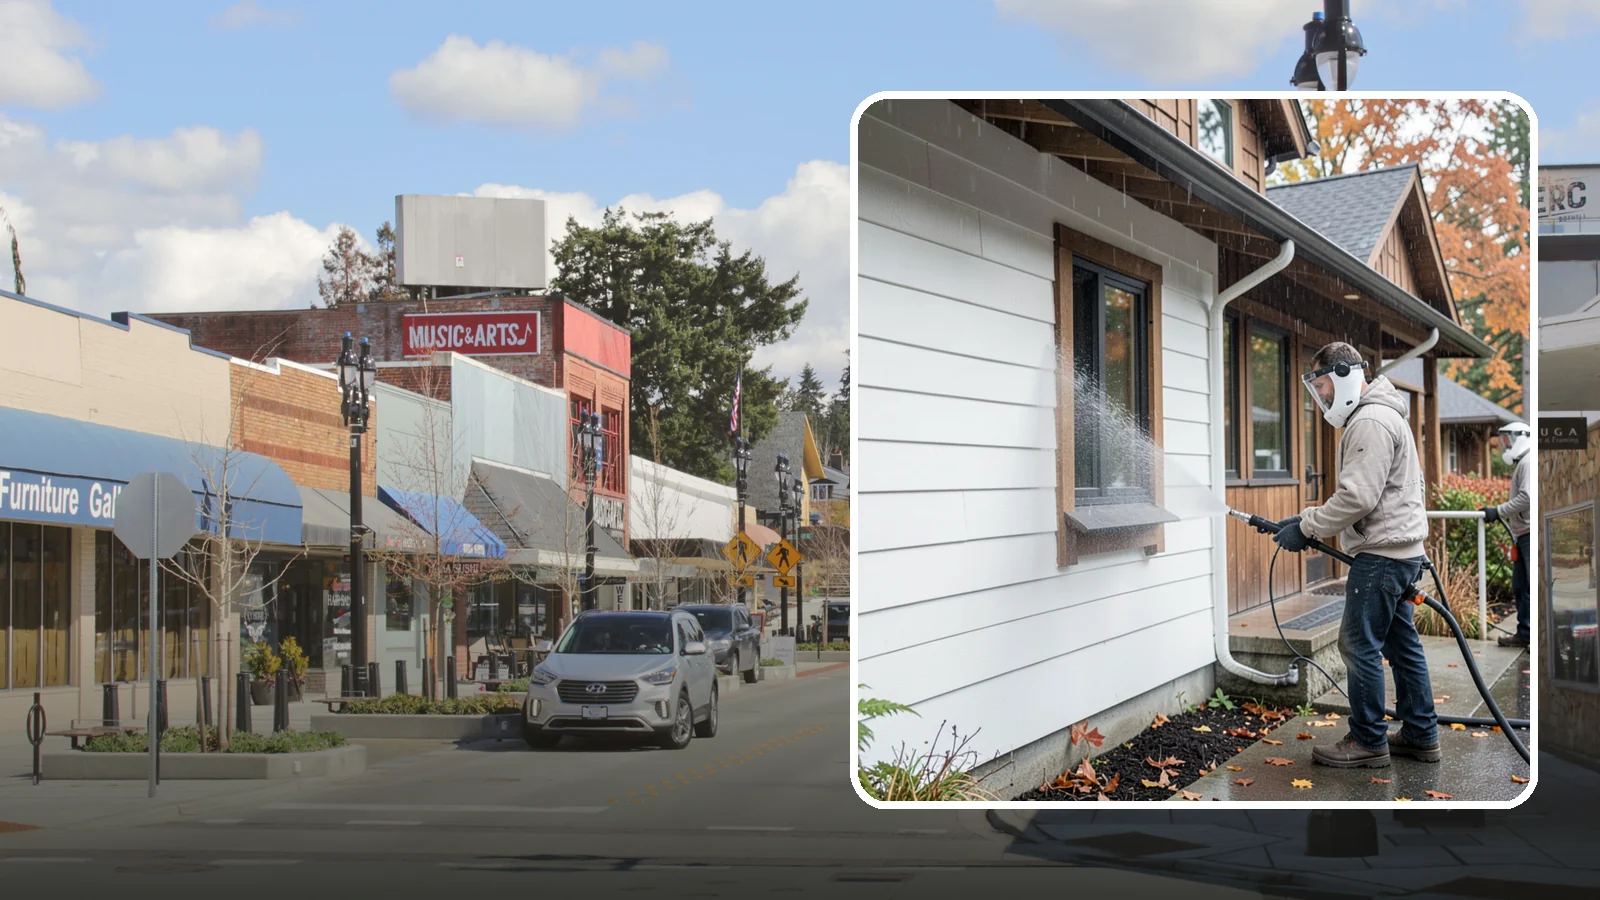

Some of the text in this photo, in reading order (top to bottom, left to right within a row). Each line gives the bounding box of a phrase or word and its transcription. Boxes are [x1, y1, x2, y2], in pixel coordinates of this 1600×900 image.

[1540, 427, 1577, 437] UGA
[0, 471, 122, 519] Furniture Gal
[453, 563, 479, 574] SUSHI
